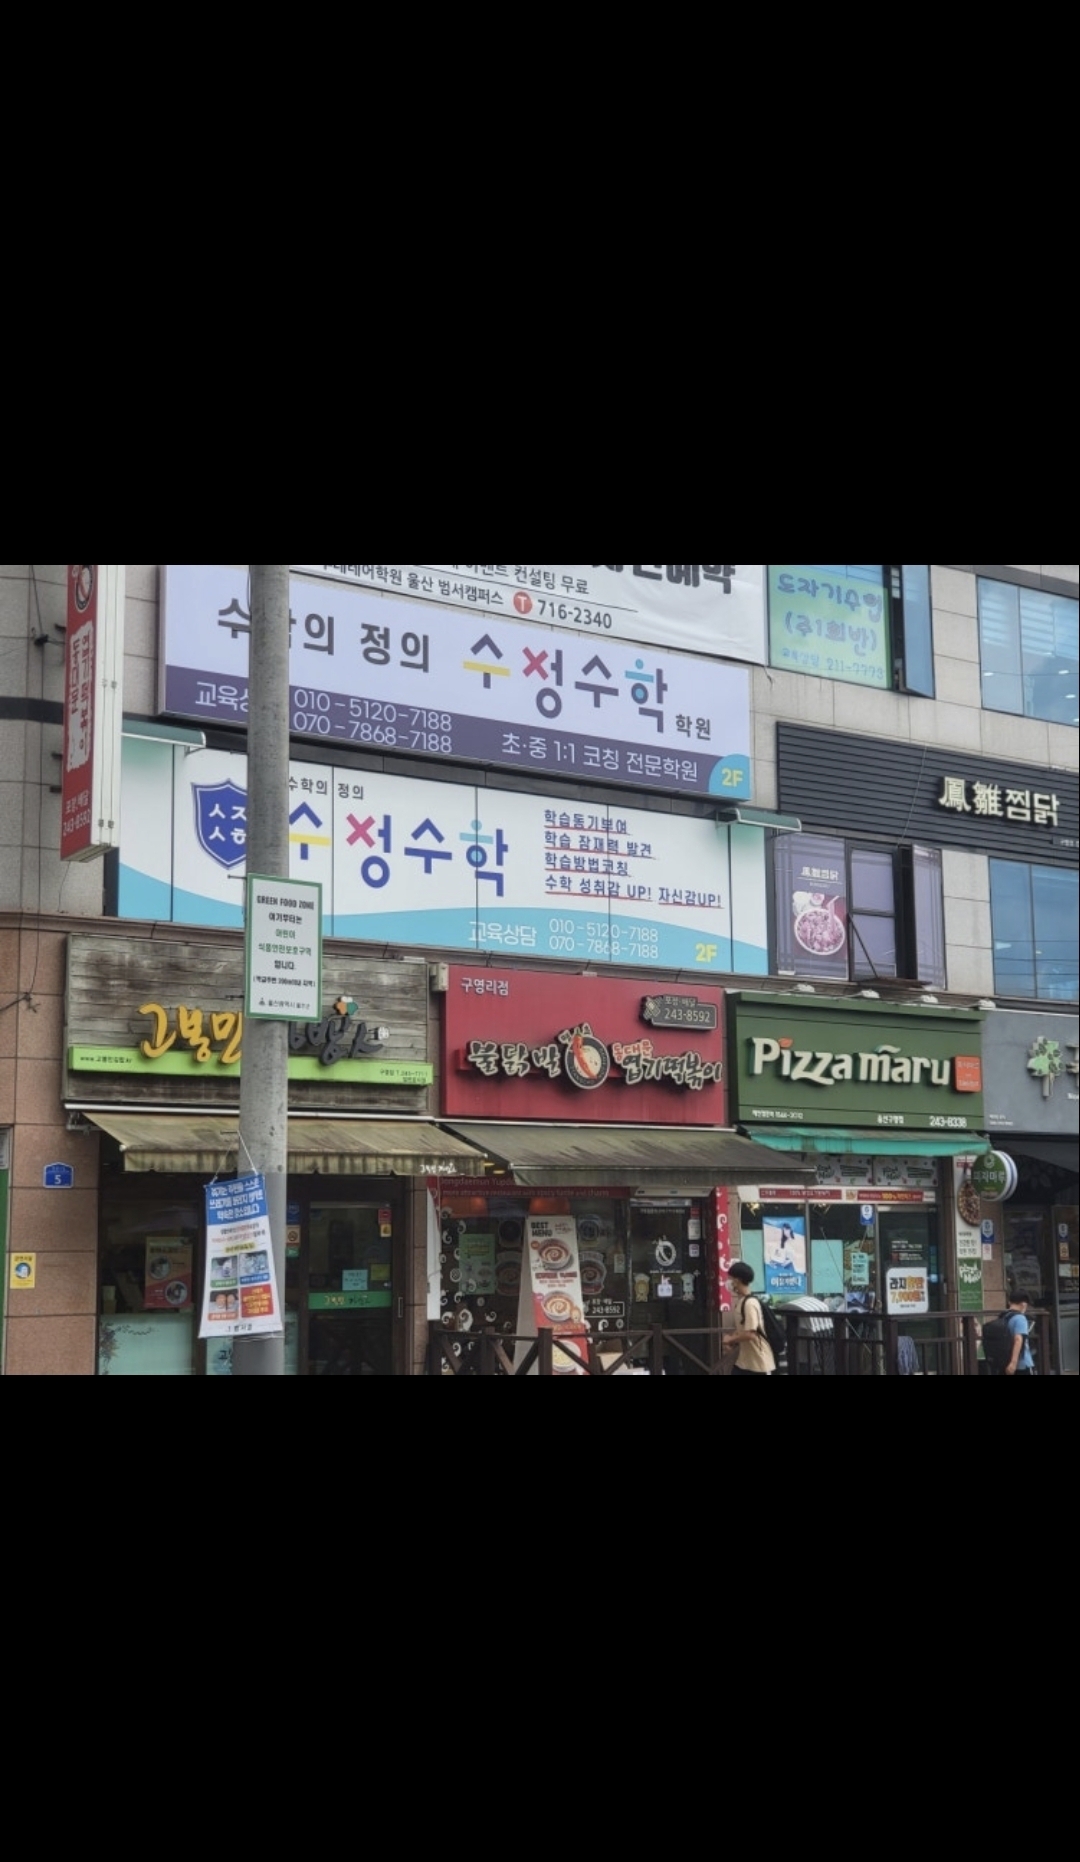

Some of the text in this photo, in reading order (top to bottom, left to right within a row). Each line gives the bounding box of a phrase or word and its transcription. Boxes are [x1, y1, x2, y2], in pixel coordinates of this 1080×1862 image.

[515, 565, 555, 590] 컨설팅
[561, 576, 589, 594] 무료
[407, 573, 434, 592] 울산
[438, 579, 503, 604] 범서캠퍼스
[538, 600, 612, 630] 716-2340
[777, 573, 883, 623] 도자기수업
[218, 598, 429, 673] 수의 정의
[293, 689, 452, 731] 010-5120-7188
[293, 711, 453, 754] 070-7868-7188
[675, 714, 711, 741] 학원
[554, 741, 576, 764] 1:1
[583, 744, 620, 771] 코칭
[626, 751, 698, 783] 전문학원
[288, 776, 364, 800] 수학의 정의
[721, 768, 743, 788] 2F
[544, 831, 653, 858] 학습 잠재력 발견
[545, 852, 629, 876] 학습방법코칭
[545, 874, 572, 891] 수학
[579, 877, 621, 897] 성취감
[627, 884, 652, 899] UP!
[256, 895, 315, 910] GREEN FOOD ZONE
[268, 912, 302, 924] 여기부터는
[275, 929, 296, 939] 어린이
[468, 920, 537, 945] 교육상담
[695, 942, 718, 963] 2F
[461, 977, 509, 996] 구영리점
[664, 1008, 711, 1023] 243-8592
[612, 1038, 653, 1065] 동대문
[750, 1037, 852, 1086] Pizza
[622, 1052, 722, 1090] 엽기떡볶이
[54, 1174, 62, 1185] 5
[532, 1229, 553, 1237] MENU
